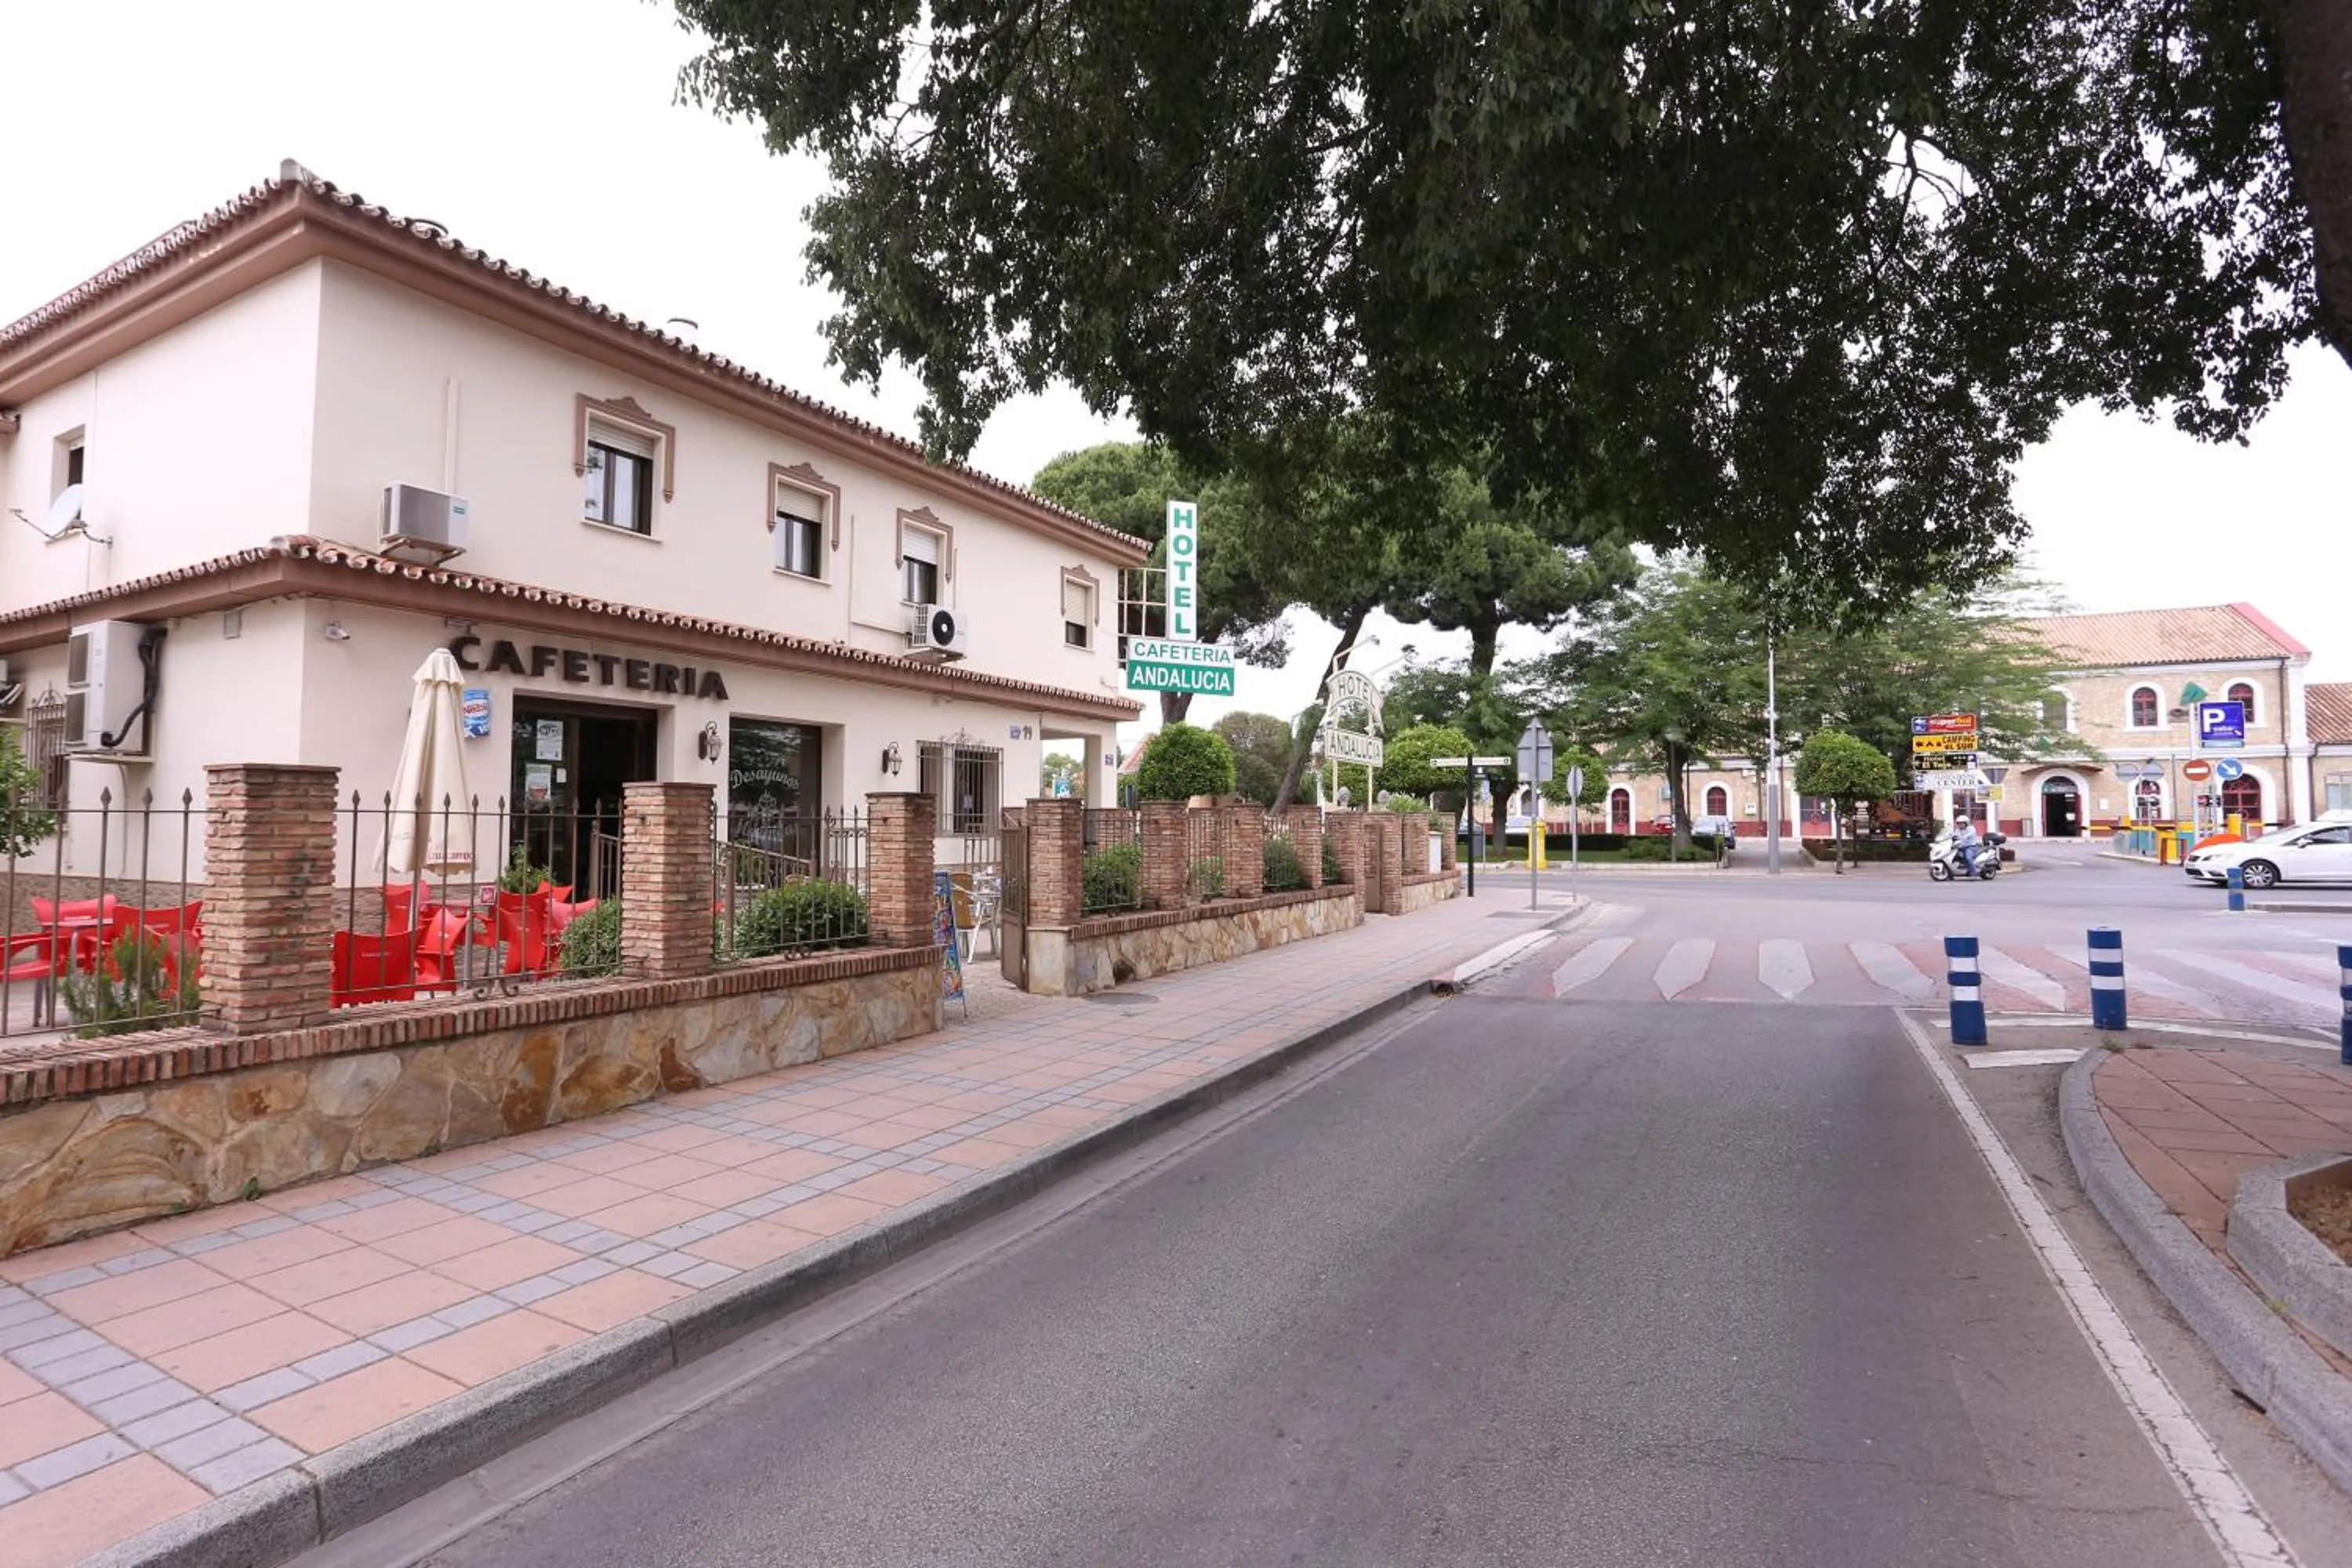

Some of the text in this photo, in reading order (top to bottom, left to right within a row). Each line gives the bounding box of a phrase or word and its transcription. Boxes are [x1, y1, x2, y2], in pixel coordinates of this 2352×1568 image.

[1173, 508, 1193, 634] HOTEL
[1134, 641, 1231, 664] CAFETERIA
[448, 636, 729, 700] CAFETERIA
[1131, 666, 1231, 691] ANDALUCIA
[1336, 675, 1377, 710] HOTEL
[2202, 708, 2226, 733] P
[1942, 735, 1975, 744] CAMPING
[730, 768, 799, 789] Desayunos
